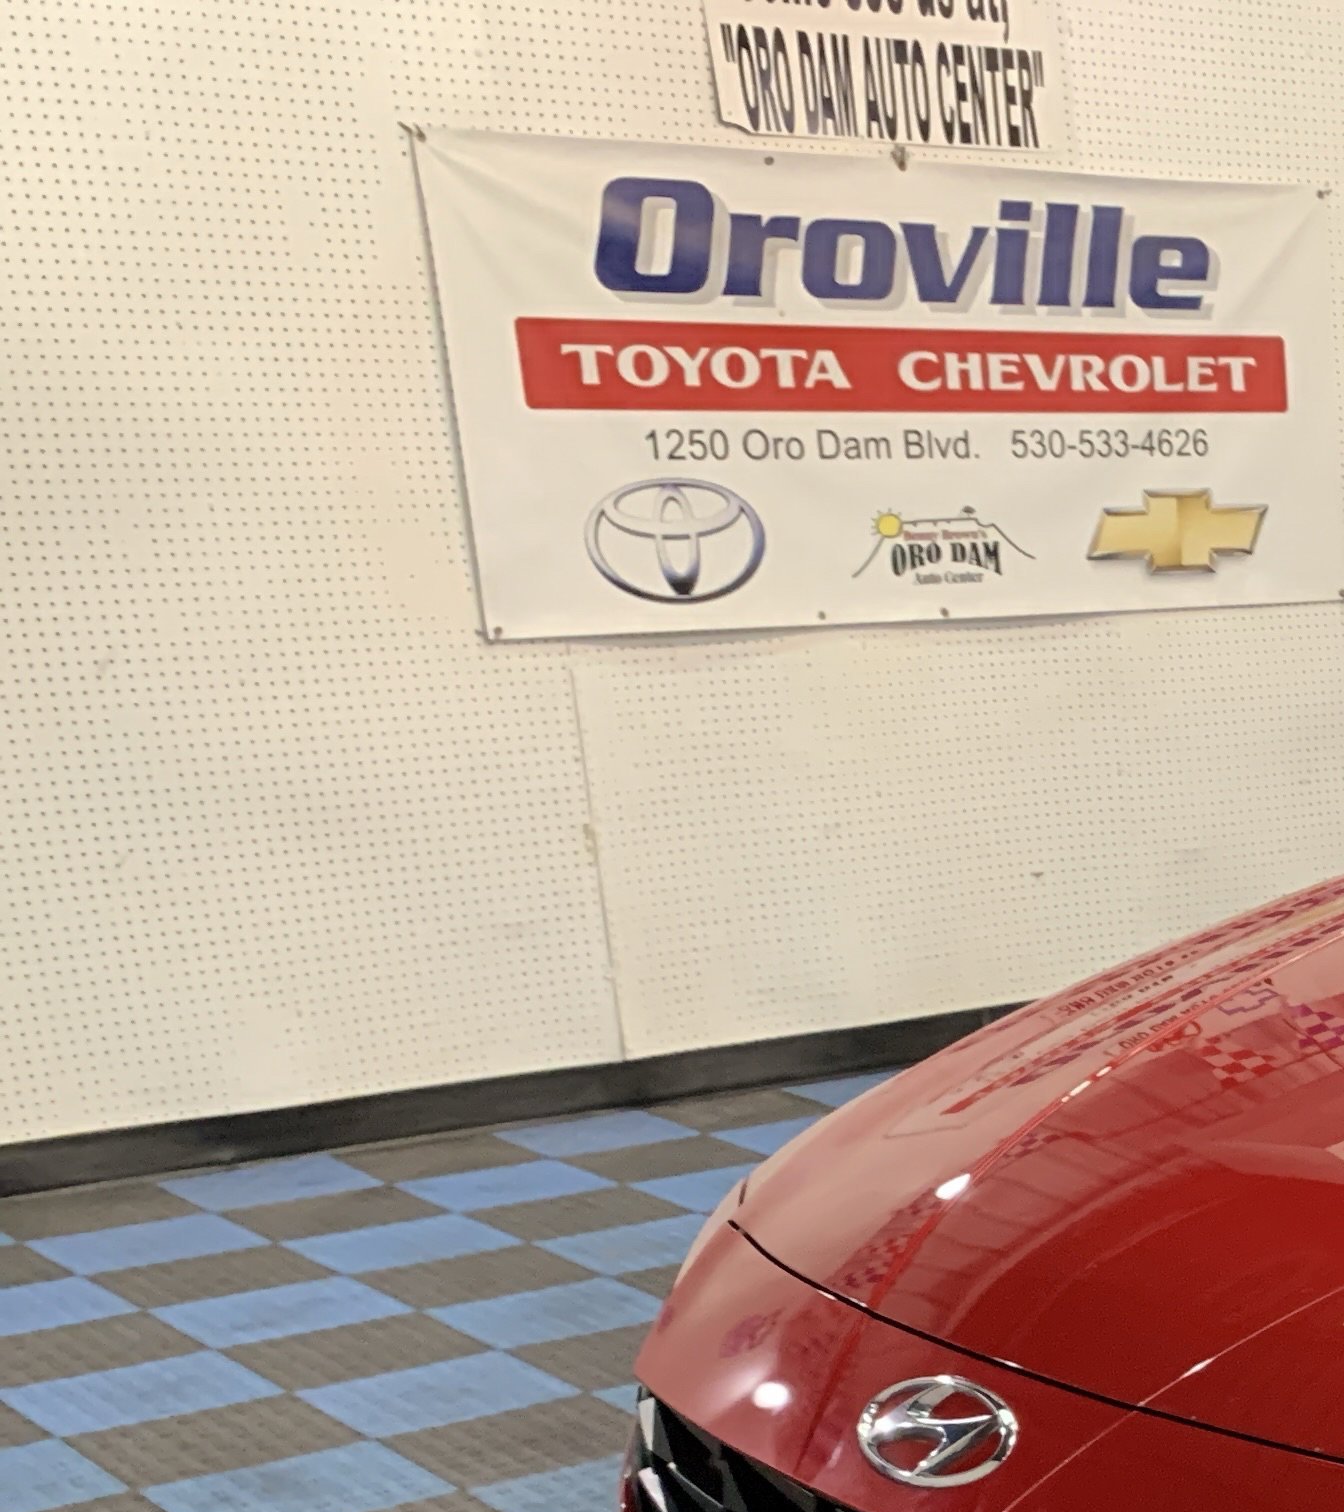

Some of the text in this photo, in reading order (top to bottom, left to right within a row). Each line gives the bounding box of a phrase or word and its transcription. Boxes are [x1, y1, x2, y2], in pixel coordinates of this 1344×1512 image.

[720, 23, 1045, 148] "ORO DAM AUTO CENTER"
[593, 175, 1213, 312] Oroville
[560, 344, 1257, 394] TOYOTA CHEVROLET
[645, 429, 1210, 461] 1250 Oro Dam Blvd. 530-533-4626
[891, 541, 1003, 577] ORO DAM
